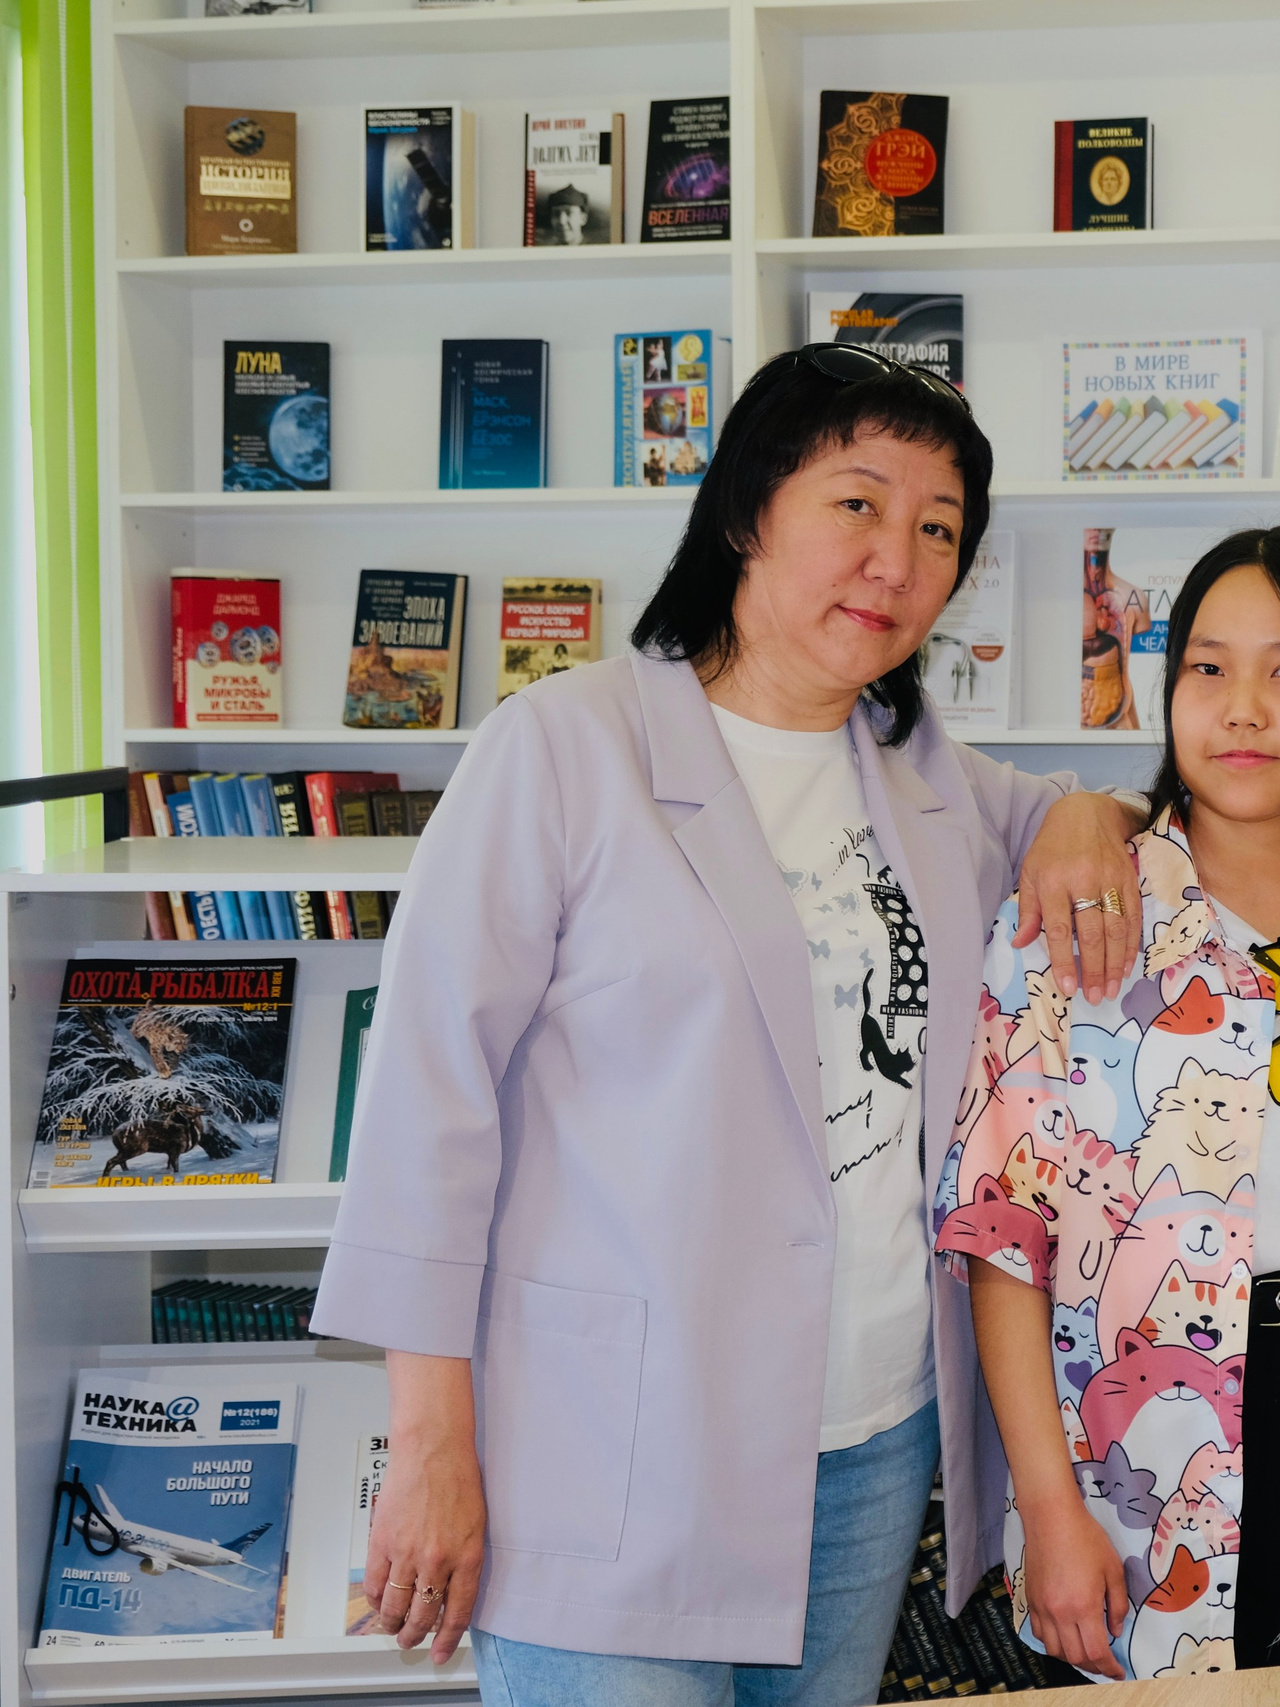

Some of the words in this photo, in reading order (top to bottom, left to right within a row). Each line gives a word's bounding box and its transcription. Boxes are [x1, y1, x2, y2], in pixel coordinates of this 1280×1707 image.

[1089, 127, 1132, 138] ВЕЛИКИЕ
[1078, 137, 1143, 149] ПОЛКОВОДЦЫ
[201, 164, 291, 181] ИСТОРИЯ
[649, 206, 729, 226] ВСЕЛЕННАЯ
[1089, 213, 1129, 223] ЛУЧШИЕ
[234, 351, 282, 374] ЛУНА
[1115, 356, 1127, 371] В
[1135, 355, 1190, 371] МИРЕ
[1085, 375, 1156, 392] НОВЫХ
[1166, 373, 1221, 390] КНИГ
[983, 579, 1000, 588] 2.0
[403, 596, 445, 620] ЭПОХА
[506, 604, 545, 614] РУССКОЕ
[546, 604, 586, 615] ВОЕННОЕ
[520, 616, 571, 627] ИСКУССТВО
[358, 620, 444, 646] ЗАВОЕВАНИЙ
[506, 626, 540, 638] ПЕРВОЙ
[542, 627, 584, 639] МИРОВОЙ
[204, 688, 271, 698] МИКРОБЫ
[210, 701, 220, 710] И
[223, 701, 265, 711] СТАЛЬ
[69, 971, 141, 999] ОХОТА
[149, 972, 269, 999] РЫБАЛКА
[882, 1006, 895, 1014] NEW
[898, 1006, 923, 1015] FASHION
[84, 1393, 166, 1416] НАУКА
[83, 1410, 197, 1433] ТЕХНИКА
[192, 1459, 253, 1475] НАЧАЛО
[166, 1476, 252, 1493] БОЛЬШОГО
[210, 1492, 250, 1506] ПУТИ
[61, 1567, 132, 1584] ДВИГАТЕЛЬ
[58, 1583, 143, 1614] ПД-14
[46, 1635, 57, 1646] 24
